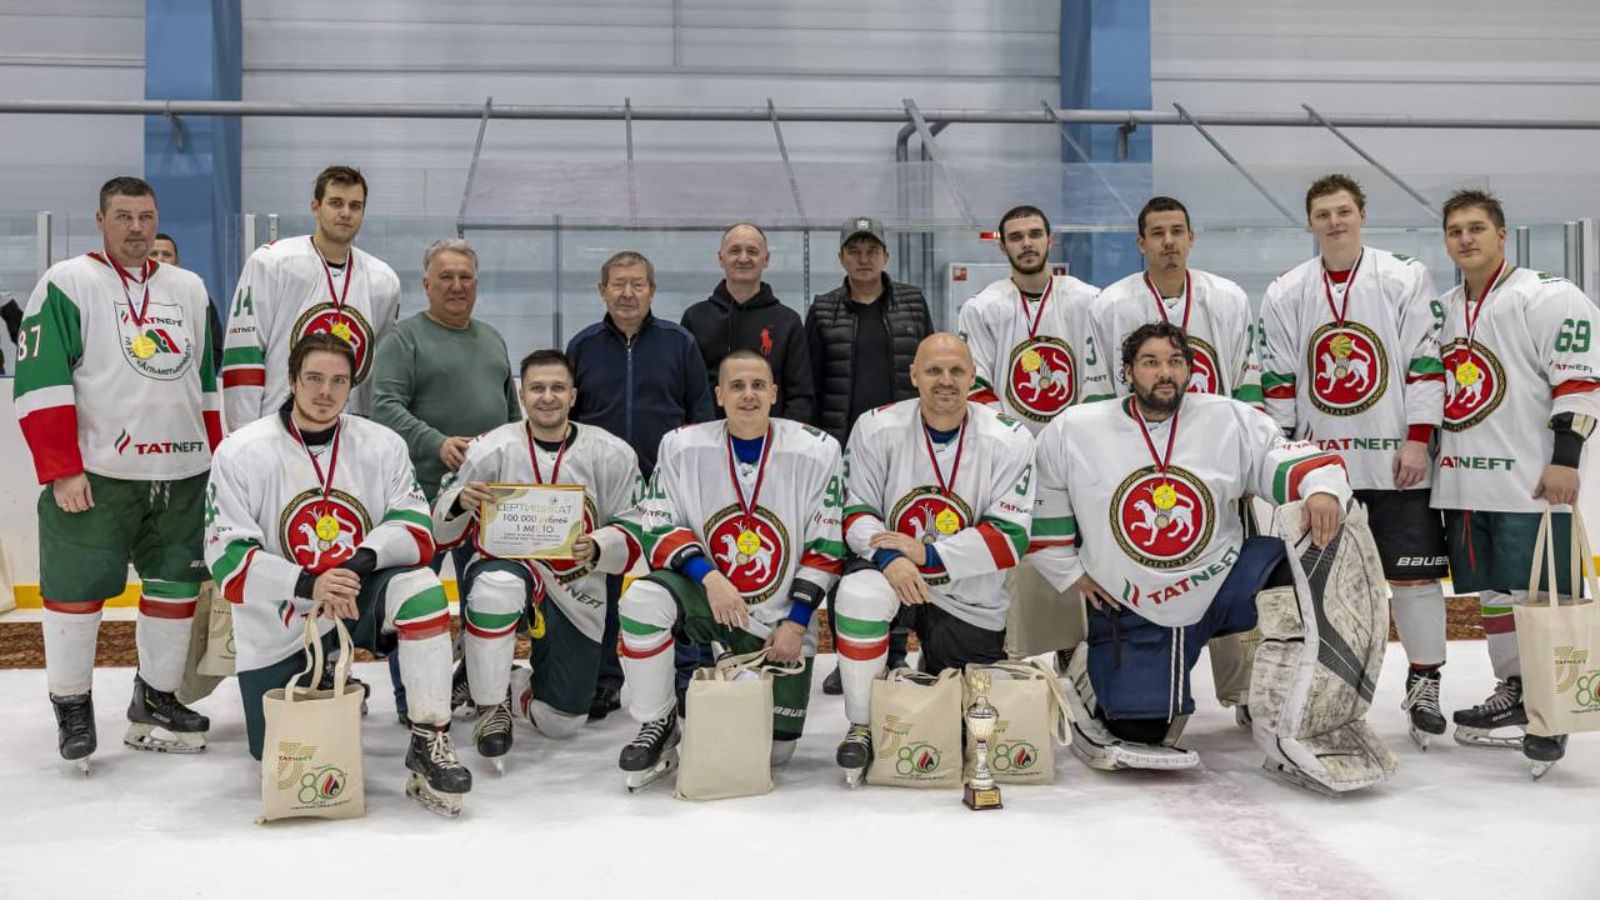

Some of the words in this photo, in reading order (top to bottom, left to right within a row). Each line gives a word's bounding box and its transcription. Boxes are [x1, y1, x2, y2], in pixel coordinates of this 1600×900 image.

[140, 317, 182, 327] ATNEFT
[1555, 319, 1591, 352] 69
[18, 325, 41, 361] 87
[134, 441, 204, 455] TATNEFT
[1316, 438, 1402, 451] TATNEFT
[1440, 456, 1516, 470] ATNEFT
[503, 514, 519, 522] 100
[520, 514, 537, 522] 000
[523, 525, 554, 533] МЕТО
[1147, 546, 1240, 605] TATNEFT
